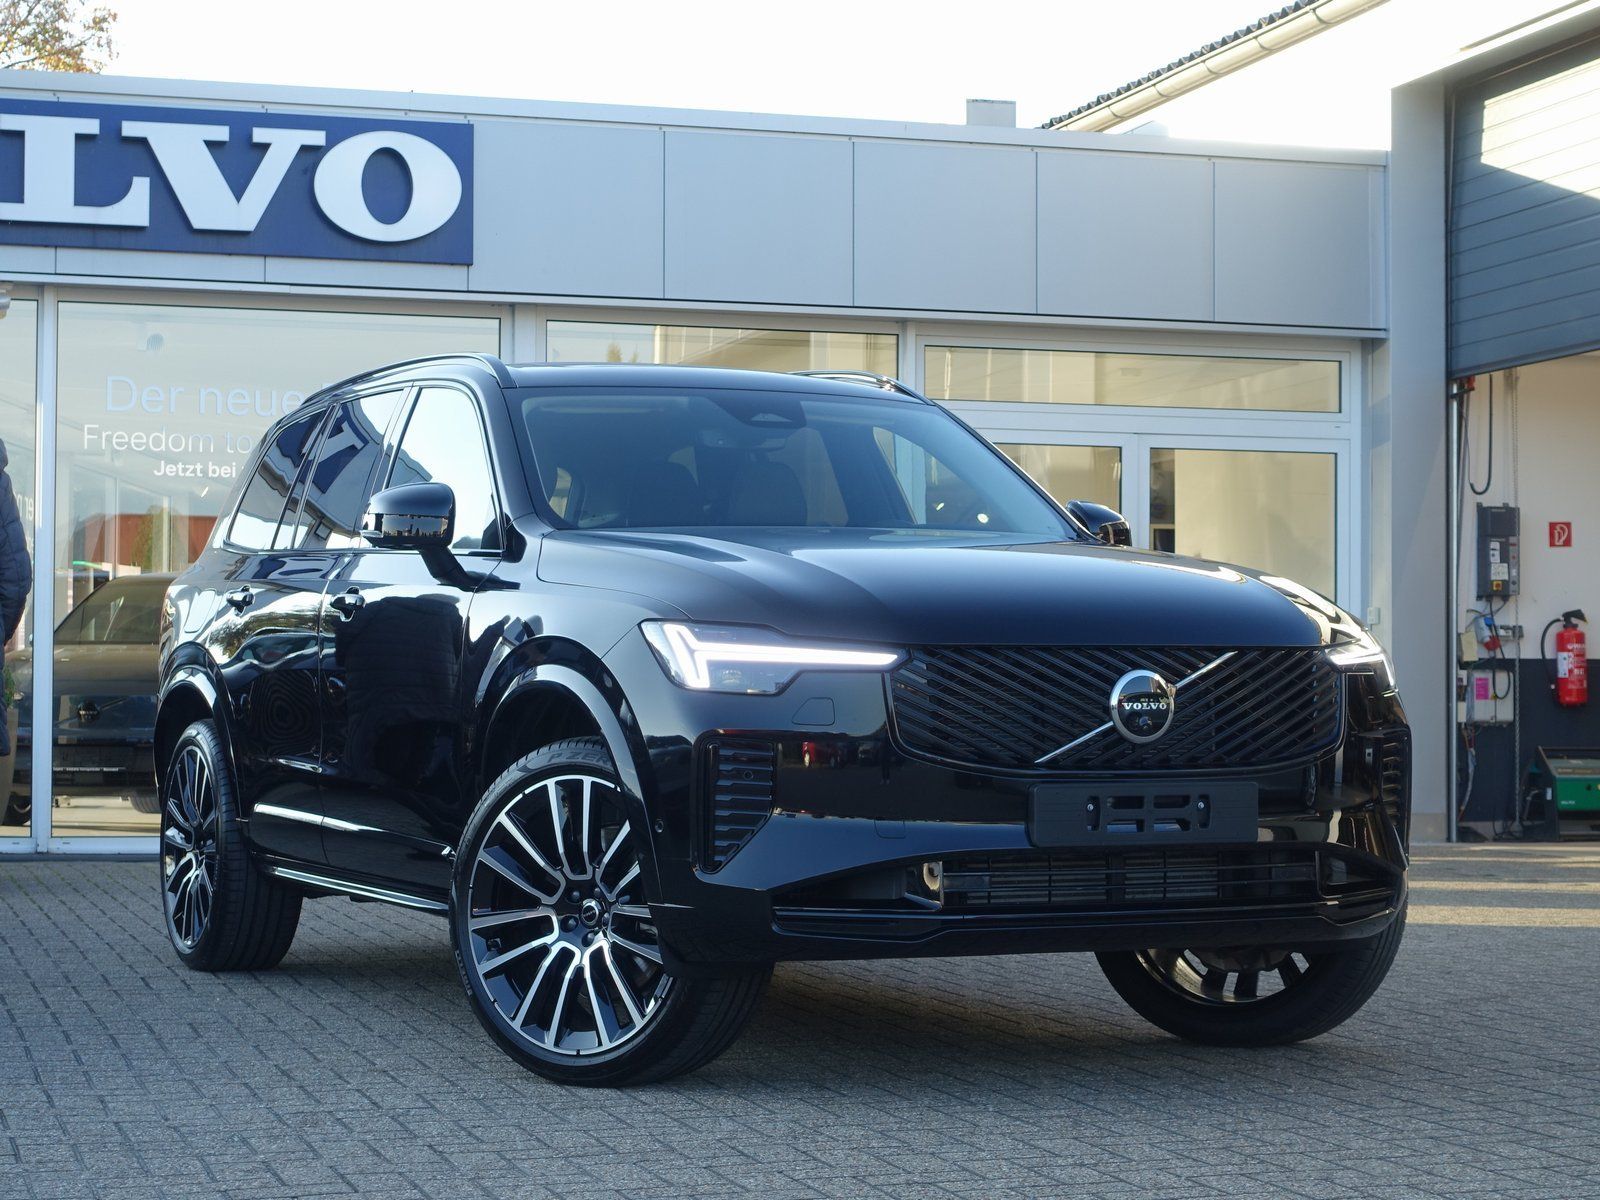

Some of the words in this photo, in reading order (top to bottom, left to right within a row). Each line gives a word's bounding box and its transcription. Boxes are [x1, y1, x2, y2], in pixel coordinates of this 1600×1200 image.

[105, 375, 185, 414] Der
[199, 384, 305, 417] neue
[83, 424, 215, 453] Freedom
[224, 431, 253, 454] to
[153, 460, 204, 478] Jetzt
[208, 461, 237, 478] bei
[1121, 702, 1167, 710] VOLVO
